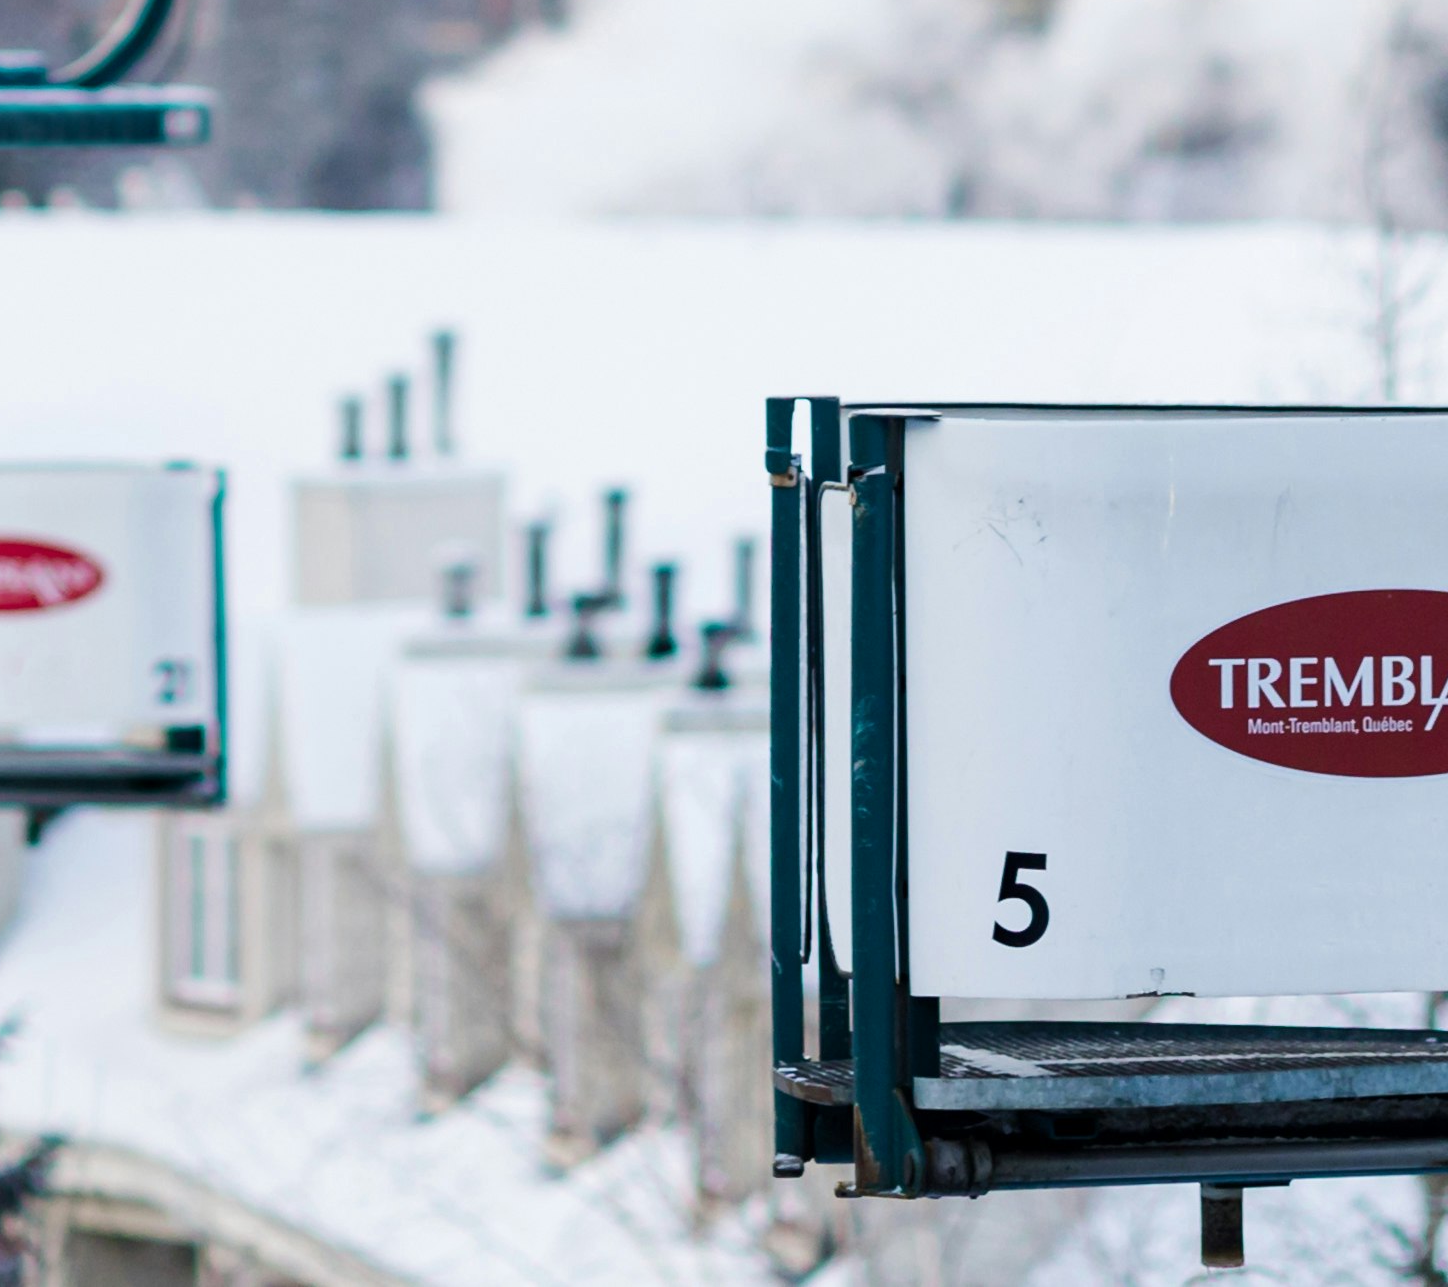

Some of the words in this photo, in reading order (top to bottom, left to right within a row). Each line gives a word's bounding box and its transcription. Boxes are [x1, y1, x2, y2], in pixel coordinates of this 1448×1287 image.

[1247, 717, 1360, 735] Mont-Tremblant,
[1362, 716, 1413, 734] Québec
[992, 850, 1050, 948] 5
